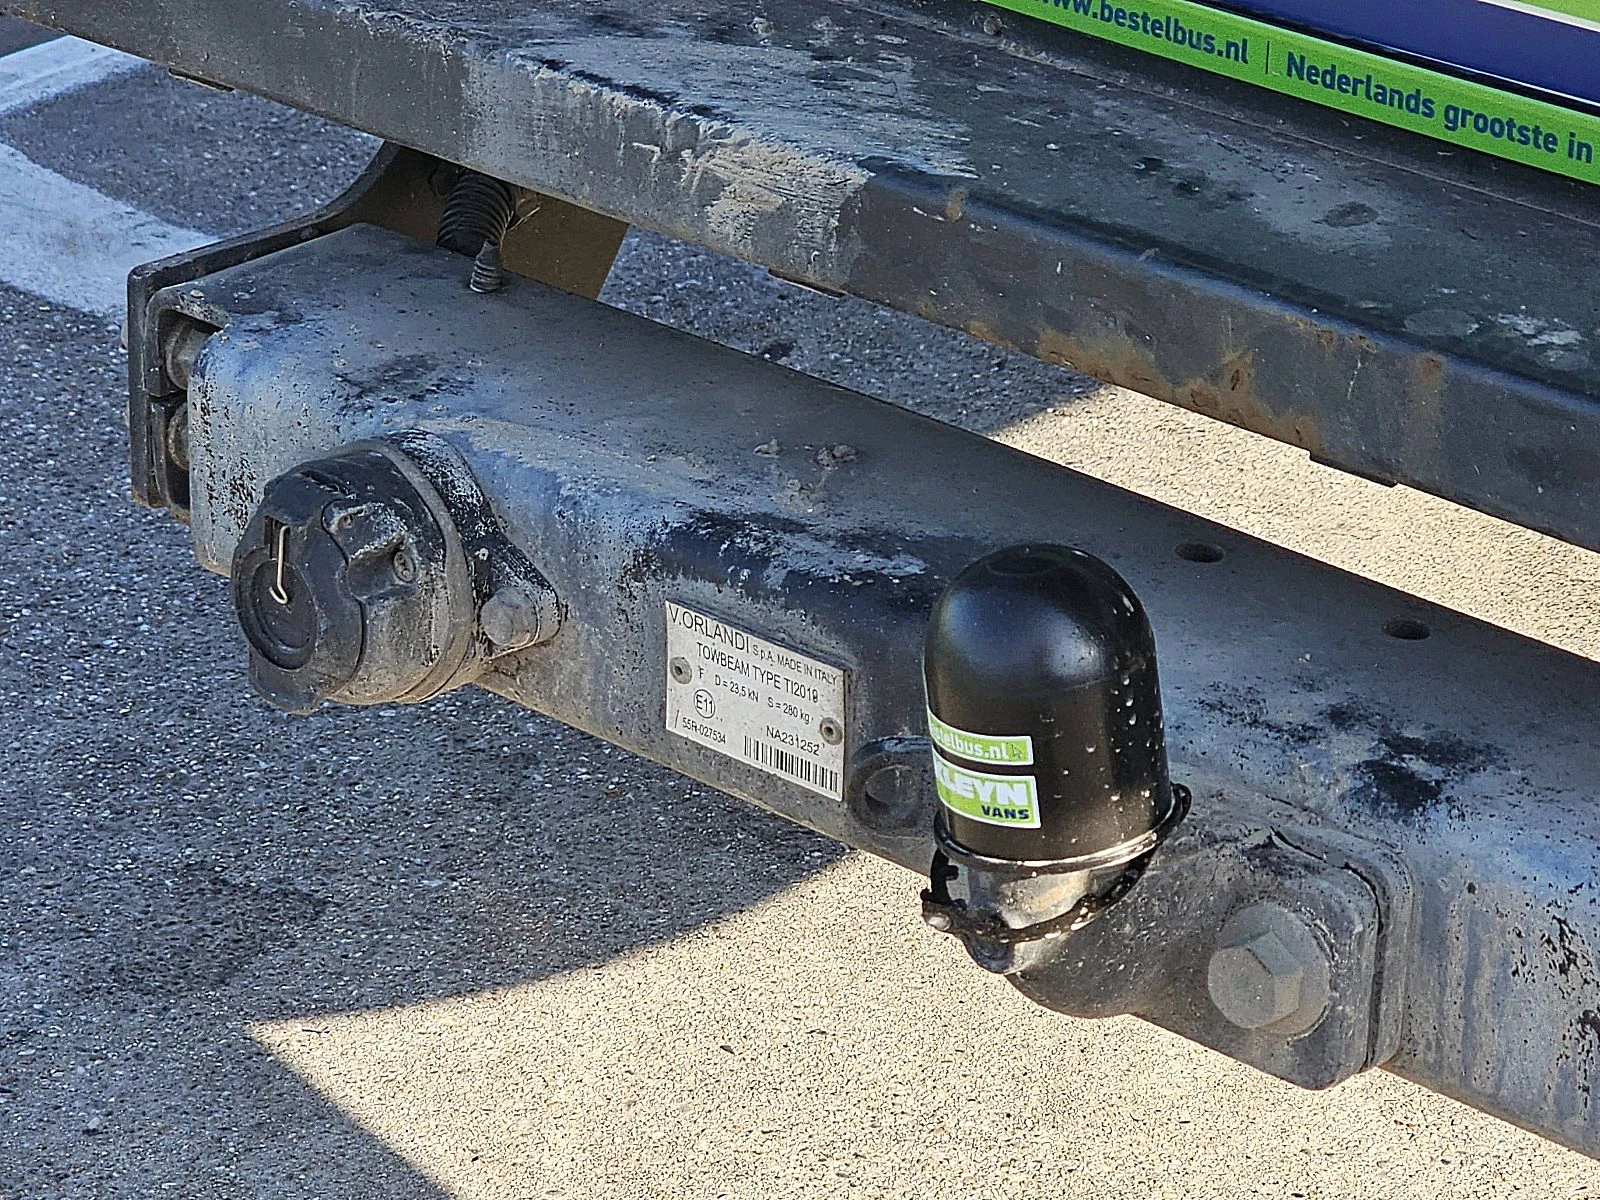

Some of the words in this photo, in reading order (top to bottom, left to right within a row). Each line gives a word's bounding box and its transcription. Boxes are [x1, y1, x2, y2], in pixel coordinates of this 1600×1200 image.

[1036, 0, 1249, 64] w.bestelbus.nl
[1286, 52, 1435, 119] Nederlands
[1444, 104, 1558, 154] grootste
[1568, 132, 1593, 163] in
[669, 606, 750, 653] V.ORLANDI
[778, 655, 802, 670] MADE
[804, 663, 813, 675] IN
[814, 669, 837, 685] ITALY
[697, 642, 750, 676] TOWBEAM
[753, 665, 781, 690] TYPE
[696, 695, 713, 714] E11
[715, 675, 721, 686] D
[729, 681, 747, 697] 23,5
[748, 688, 759, 702] kN
[768, 697, 774, 708] S
[783, 703, 798, 718] 280
[800, 708, 810, 724] kg
[767, 726, 820, 756] NA231252
[981, 805, 1030, 819] VANS
